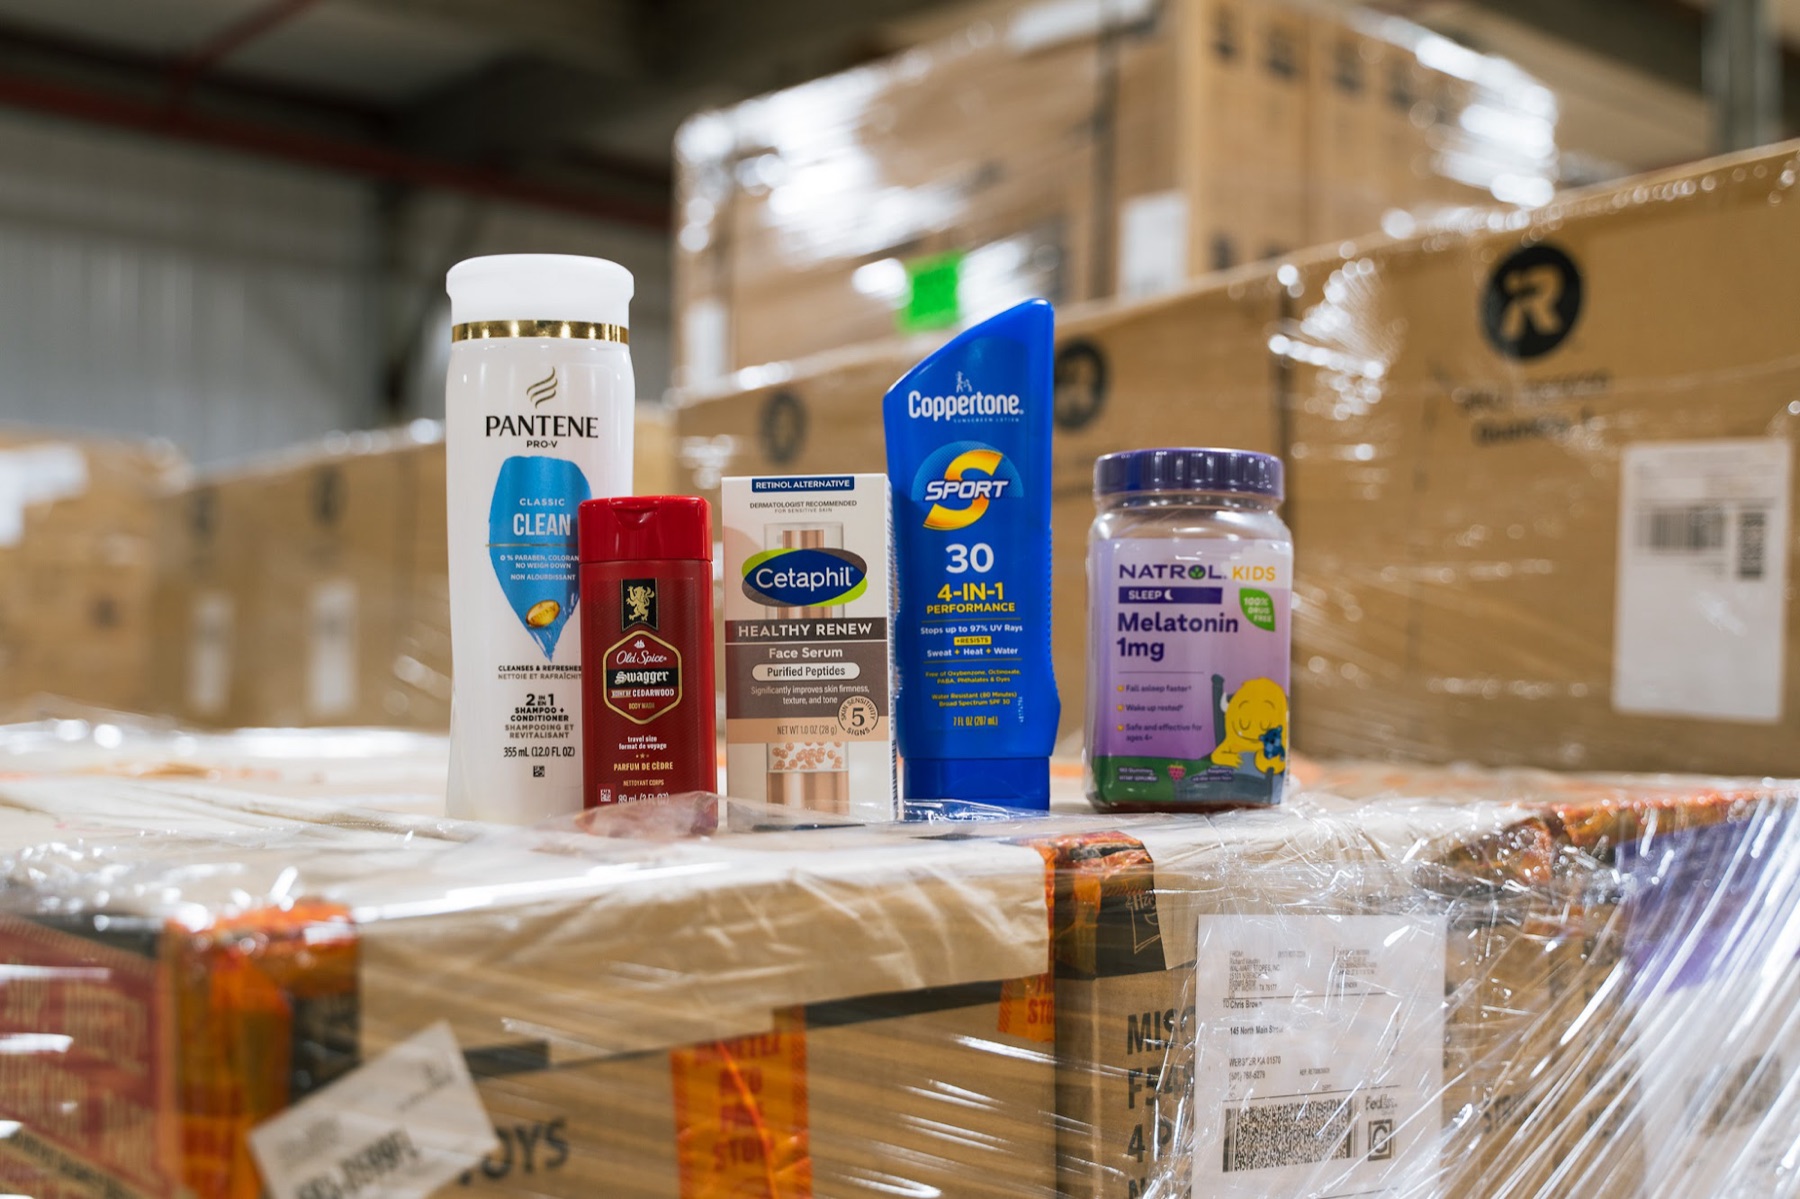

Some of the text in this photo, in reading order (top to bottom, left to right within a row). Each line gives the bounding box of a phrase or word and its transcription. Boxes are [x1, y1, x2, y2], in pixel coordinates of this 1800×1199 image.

[908, 390, 1019, 422] Coppertone
[485, 415, 599, 438] PANTENE
[756, 480, 850, 489] RETINOL ALTERNATIVE
[925, 480, 1009, 501] SPORT
[519, 498, 566, 507] CLASSIC
[750, 501, 804, 509] DERMATOLOGIST
[512, 513, 571, 536] CLEAN
[945, 543, 994, 574] 30
[1119, 564, 1276, 581] NATROL KIDS
[756, 567, 852, 591] Cetaphil
[937, 582, 1003, 601] 4-IN-1
[1129, 590, 1162, 600] SLEEP
[927, 602, 1015, 614] PERFORMANCE
[1118, 612, 1239, 633] Melatonin
[738, 623, 872, 637] HEALTHY RENEW
[921, 627, 943, 636] Stops
[1004, 624, 1023, 632] Rays
[769, 647, 843, 659] Face Serum
[927, 649, 952, 657] Sweat
[994, 647, 1018, 655] Water
[1117, 637, 1164, 662] 1mg
[616, 650, 663, 665] Old Spice
[614, 671, 669, 685] Swagger
[767, 666, 846, 678] Purified Peptides
[632, 689, 675, 698] CEDARWOOD
[751, 685, 869, 696] Significantly improves skin firmness,
[526, 693, 536, 706] 2
[548, 693, 554, 706] 1
[783, 696, 838, 706] texture, and tone
[847, 697, 876, 721] SENSITIVITY
[852, 707, 865, 727] 5
[777, 725, 837, 736] NET WT 1.0 OZ (28 g)
[847, 727, 871, 736] SIGNS
[645, 735, 657, 743] size
[504, 746, 576, 757] 355 mL (12.0 FL OZ)
[613, 763, 640, 771] PARFUM
[651, 761, 673, 771] CÈDRE
[1230, 1001, 1245, 1009] Chris
[1230, 1026, 1268, 1035] 145 North Main
[1266, 1056, 1281, 1064] 01570
